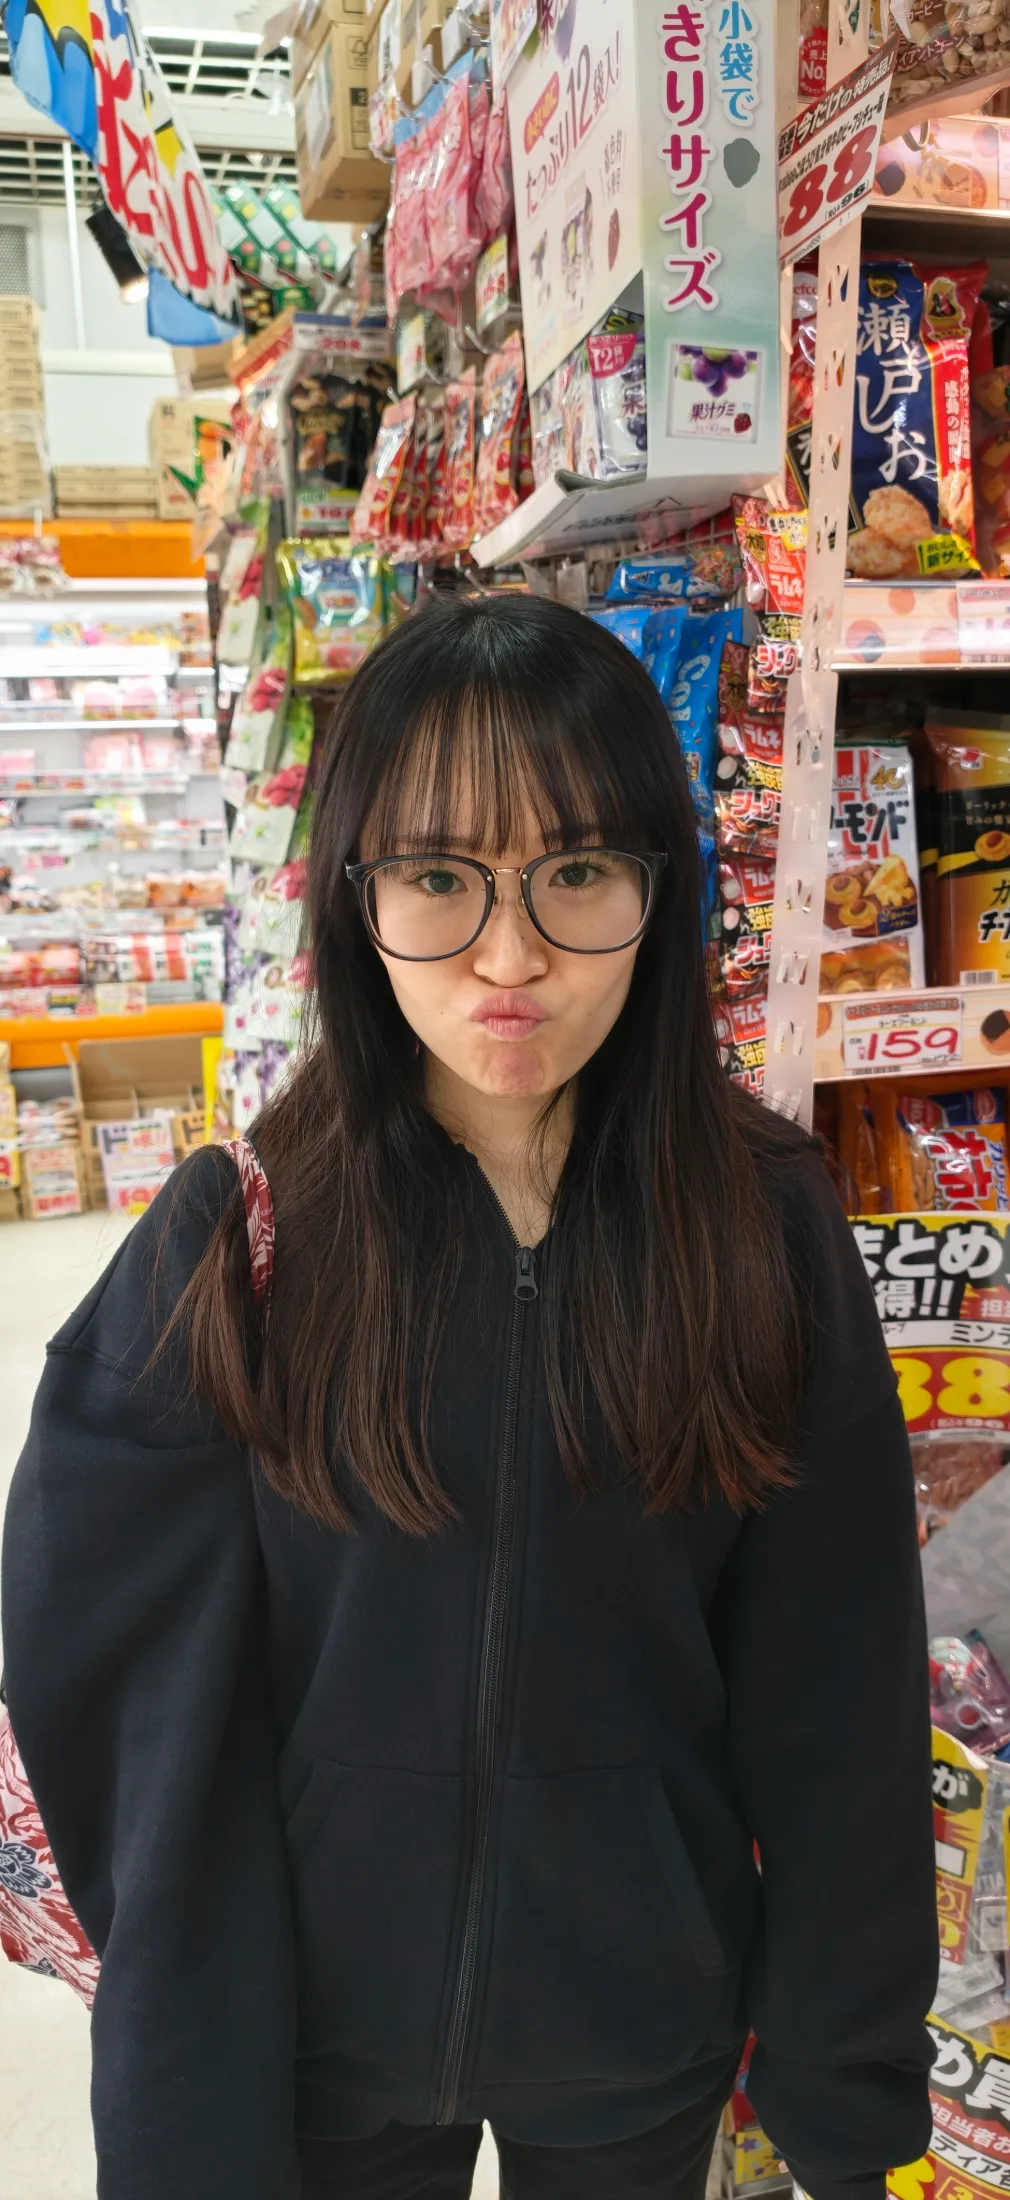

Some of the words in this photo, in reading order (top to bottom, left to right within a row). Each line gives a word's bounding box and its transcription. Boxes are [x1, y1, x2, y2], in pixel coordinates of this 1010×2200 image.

[719, 1, 754, 120] 小袋で
[662, 4, 716, 306] きりサイズ
[783, 124, 877, 237] 88
[689, 401, 736, 423] 果汁グミ
[743, 723, 780, 749] ラムネ
[830, 801, 909, 842] ーモンド
[866, 1026, 959, 1061] 159
